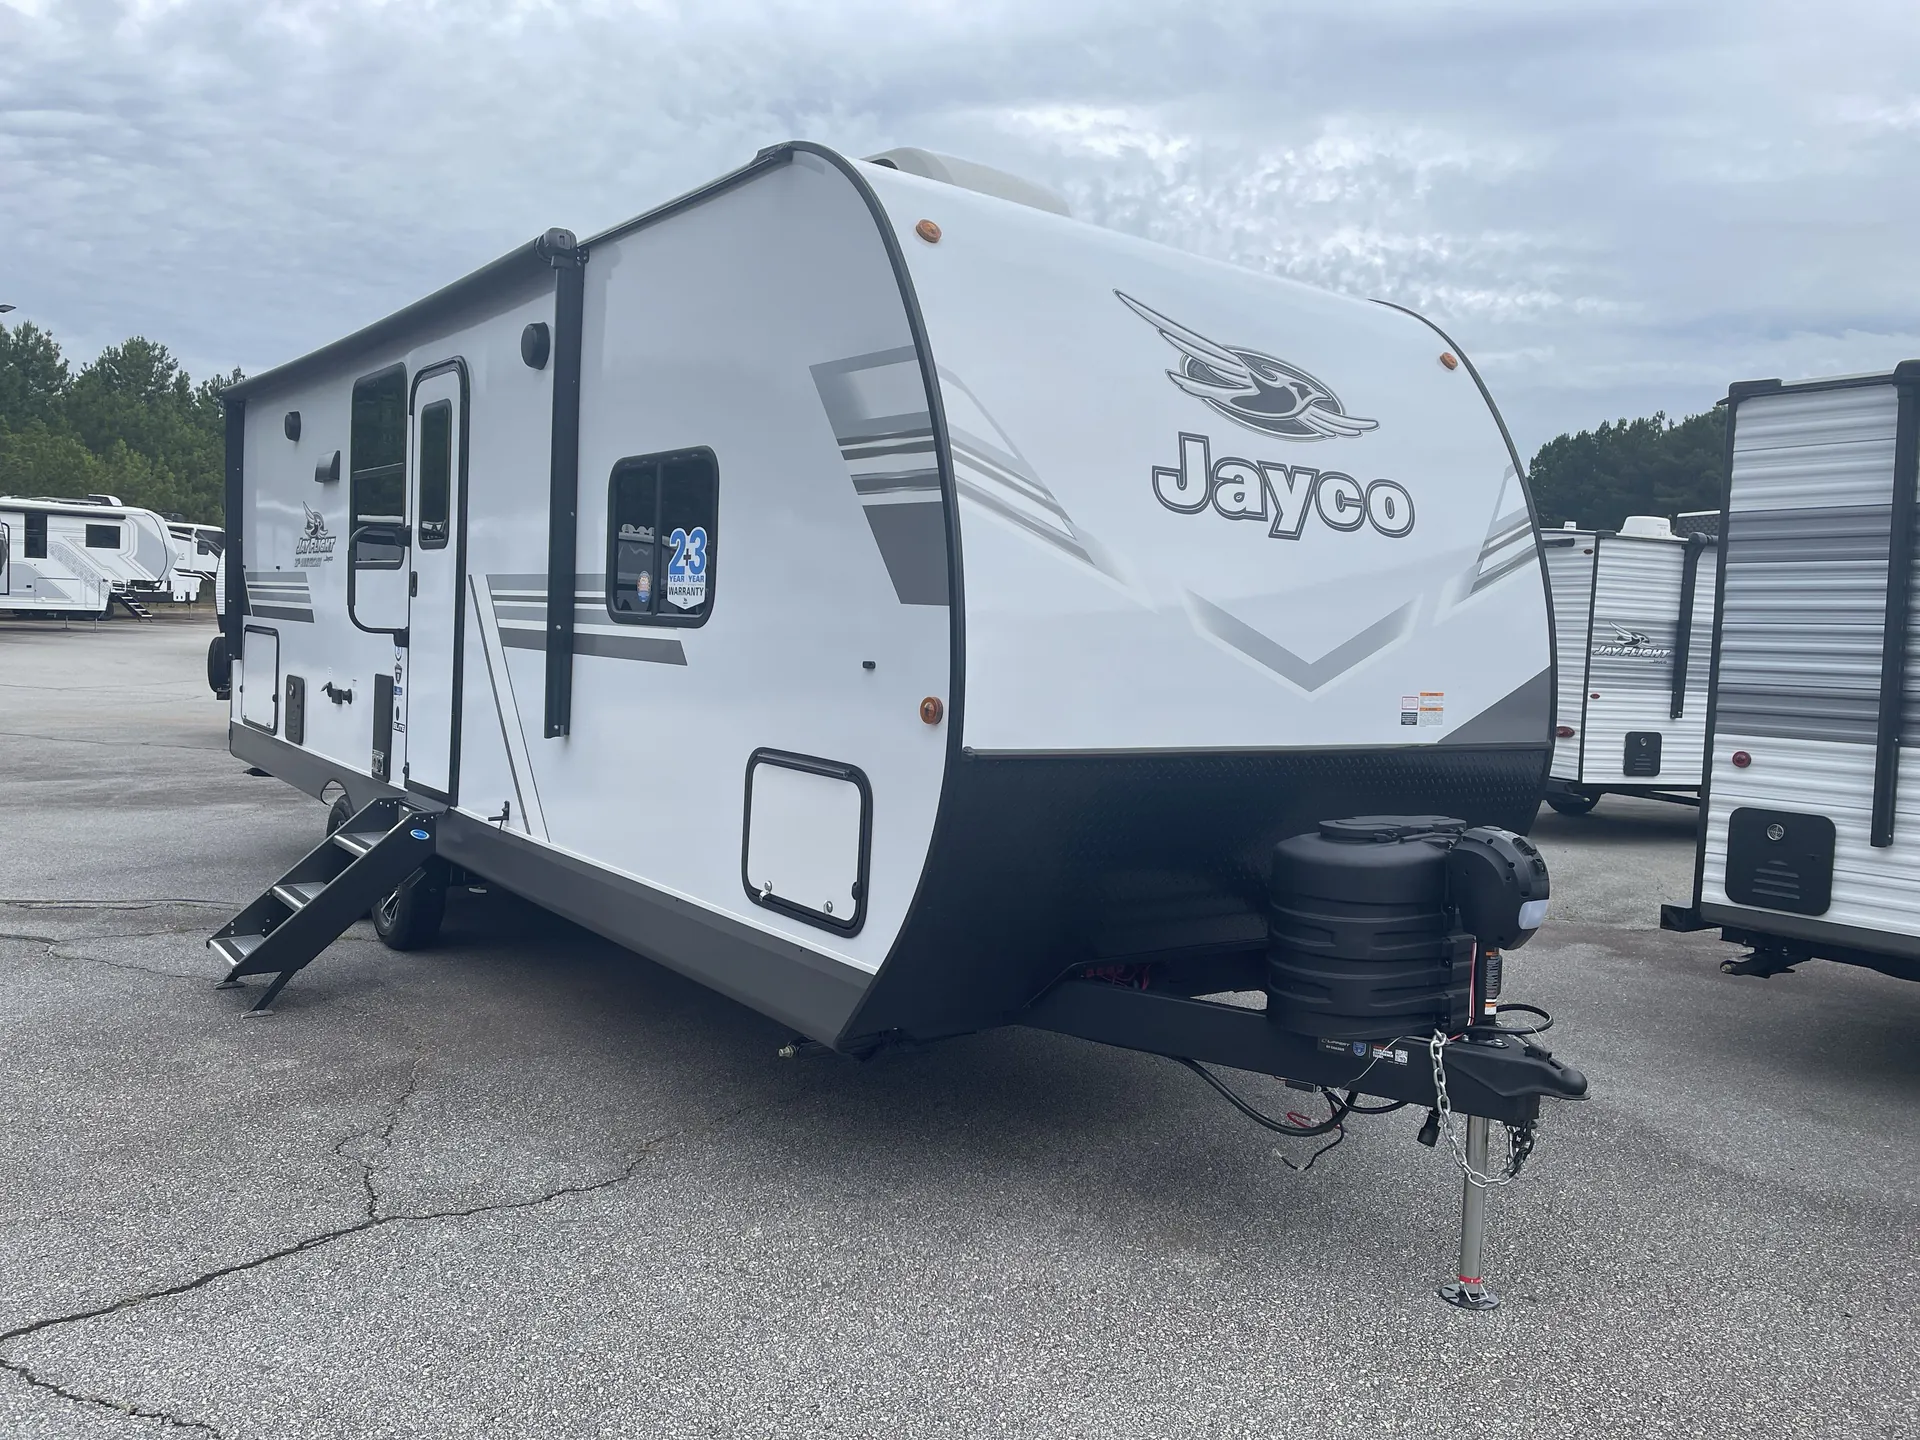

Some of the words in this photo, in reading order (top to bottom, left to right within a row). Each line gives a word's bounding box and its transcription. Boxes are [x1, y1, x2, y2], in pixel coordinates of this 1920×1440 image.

[1151, 431, 1416, 541] Jayco
[308, 536, 336, 553] FLIGHT
[669, 587, 704, 596] WARRANTY
[1593, 645, 1621, 656] JAY
[1620, 646, 1671, 658] FLIGHT
